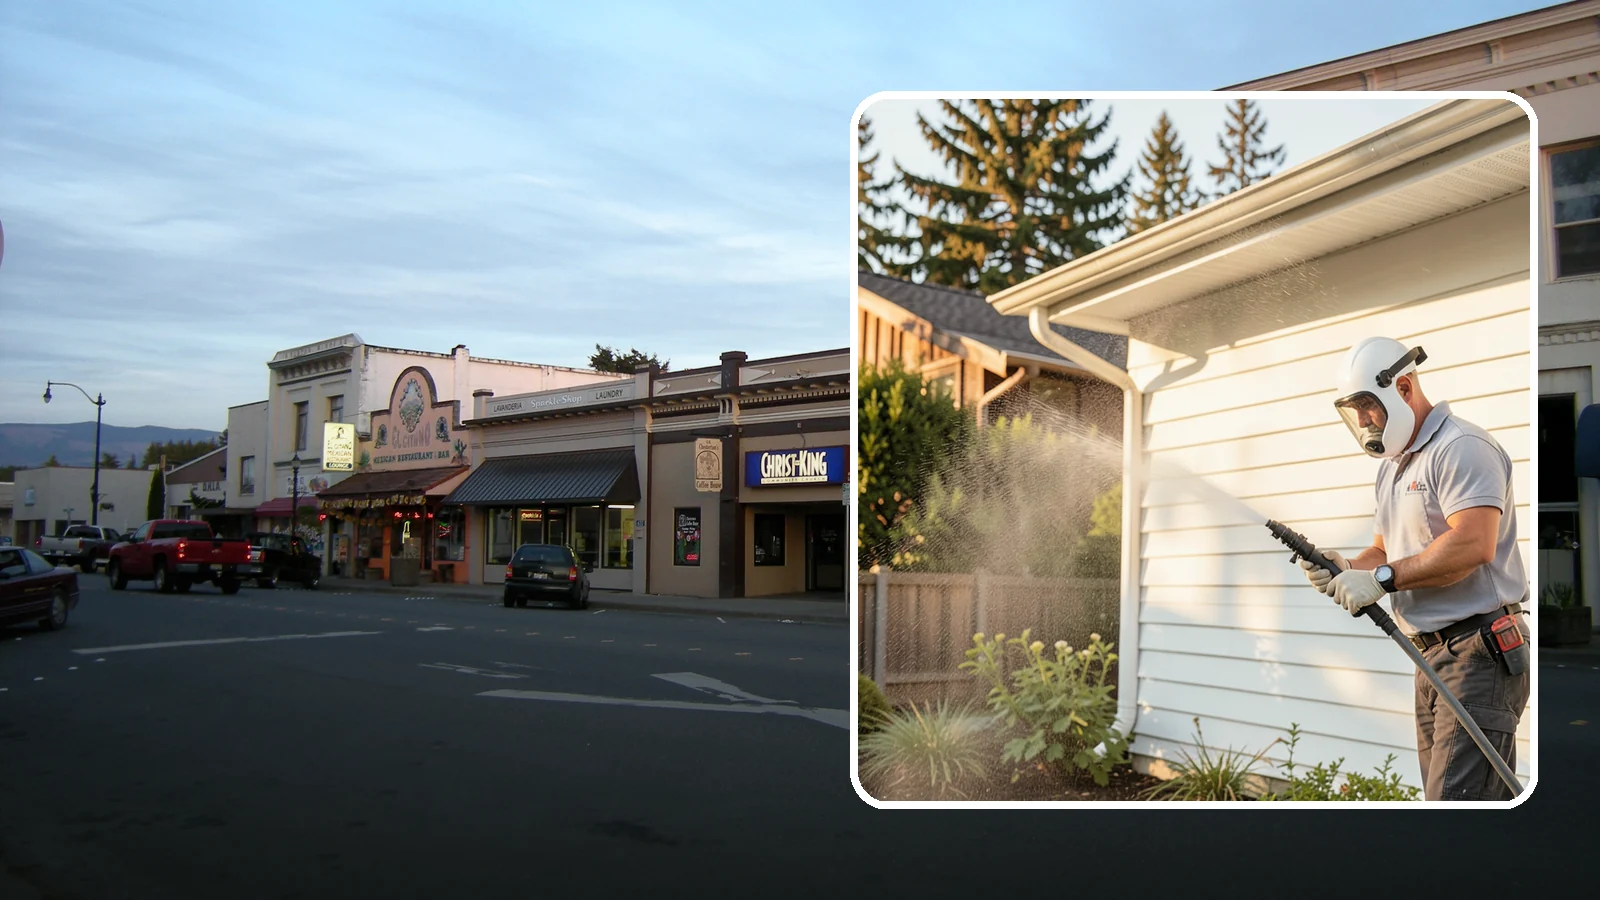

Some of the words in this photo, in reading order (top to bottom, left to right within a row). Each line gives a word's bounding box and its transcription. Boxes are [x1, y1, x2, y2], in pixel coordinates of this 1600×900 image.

[493, 402, 522, 412] LAVANDERIA
[561, 394, 582, 405] Shop
[596, 389, 623, 399] LAUNDRY
[374, 455, 397, 464] MEXICAN
[398, 452, 433, 462] RESTAURANT
[438, 450, 450, 459] BAR
[761, 452, 797, 478] CHRIST
[799, 450, 827, 476] KING
